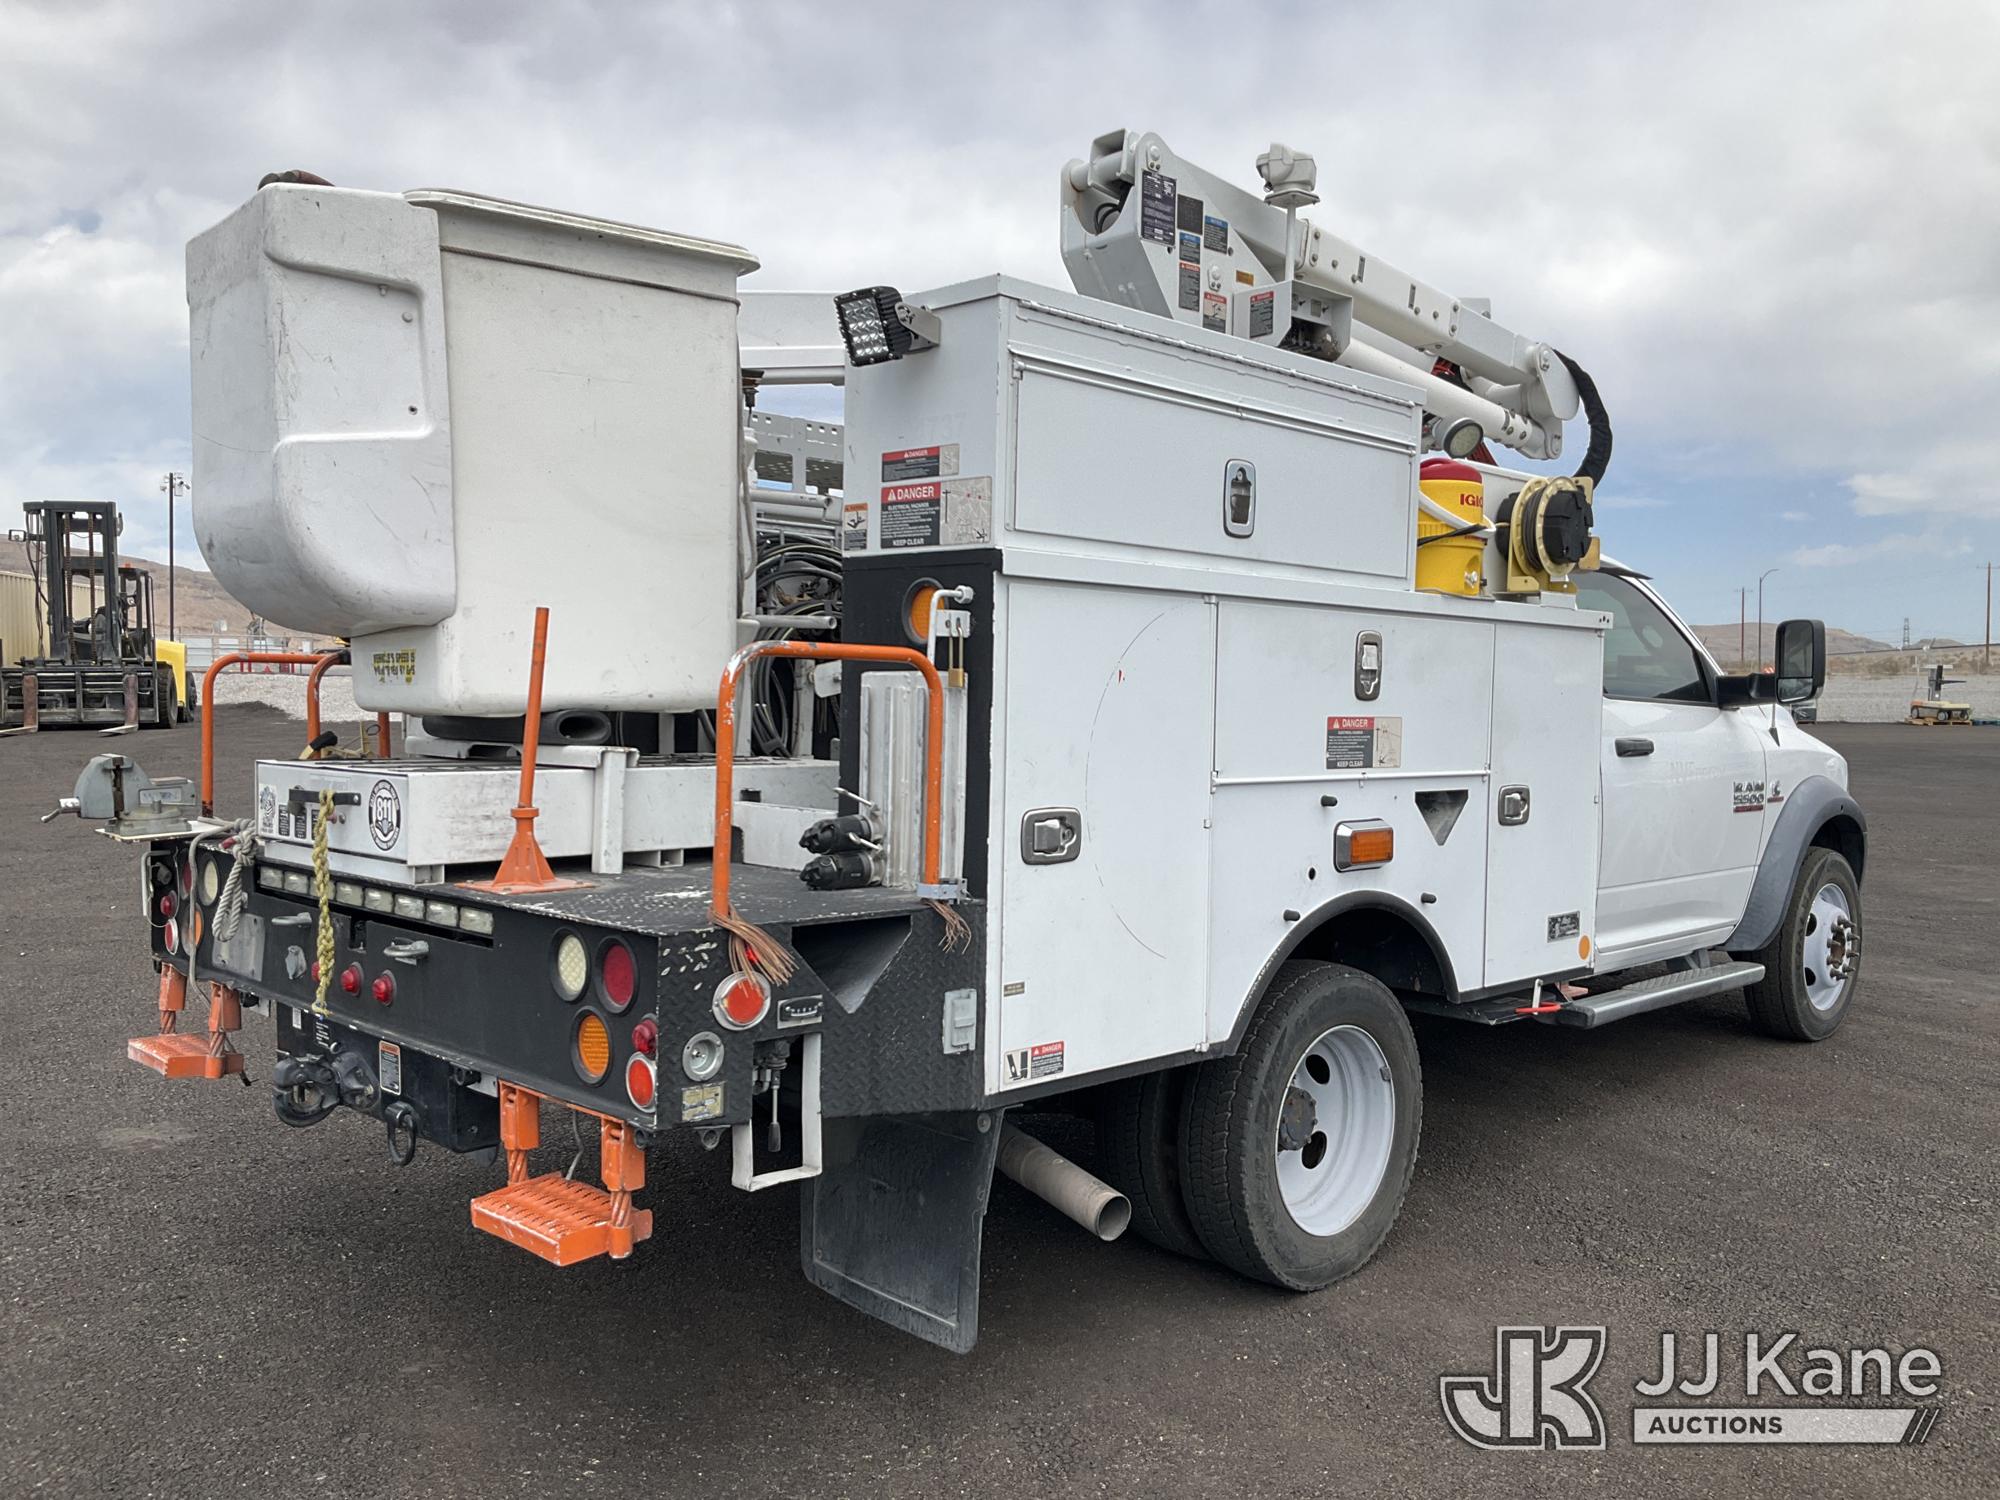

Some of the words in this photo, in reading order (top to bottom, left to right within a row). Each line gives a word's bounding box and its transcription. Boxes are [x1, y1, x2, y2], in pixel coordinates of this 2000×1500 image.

[897, 486, 934, 500] DANGER
[1342, 718, 1368, 728] DANGER
[1733, 781, 1764, 792] RAM
[1733, 792, 1764, 805] 5500
[376, 796, 392, 822] 811
